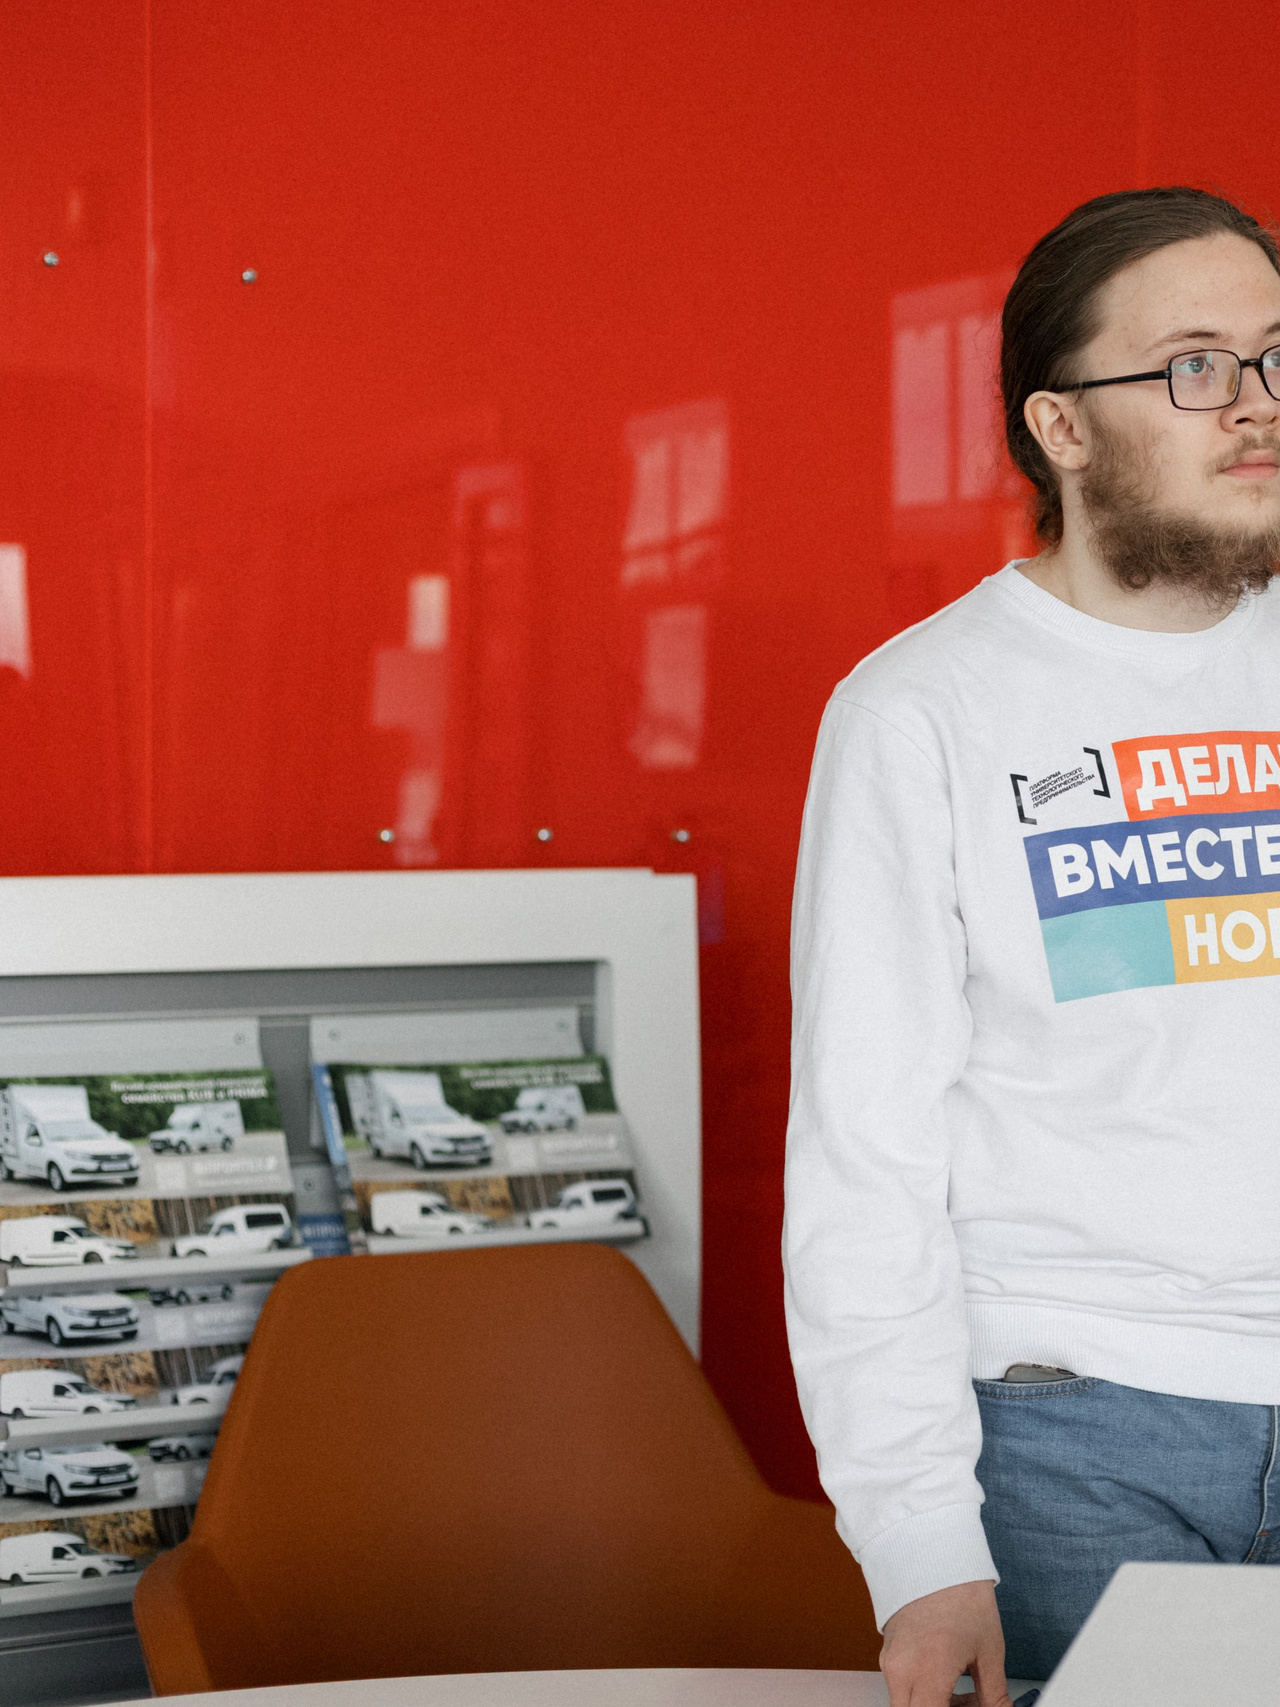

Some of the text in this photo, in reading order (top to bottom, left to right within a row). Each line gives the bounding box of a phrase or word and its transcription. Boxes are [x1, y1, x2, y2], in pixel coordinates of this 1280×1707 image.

[1029, 771, 1061, 791] ПЛАТФОРМА
[1030, 767, 1082, 797] УНИВЕРСИТЕТСКОГО
[1032, 773, 1084, 803] ТЕХНОЛОГИЧЕСКОГО
[1033, 774, 1095, 808] ПРЕДПРИНИМАТЕЛЬСТВА
